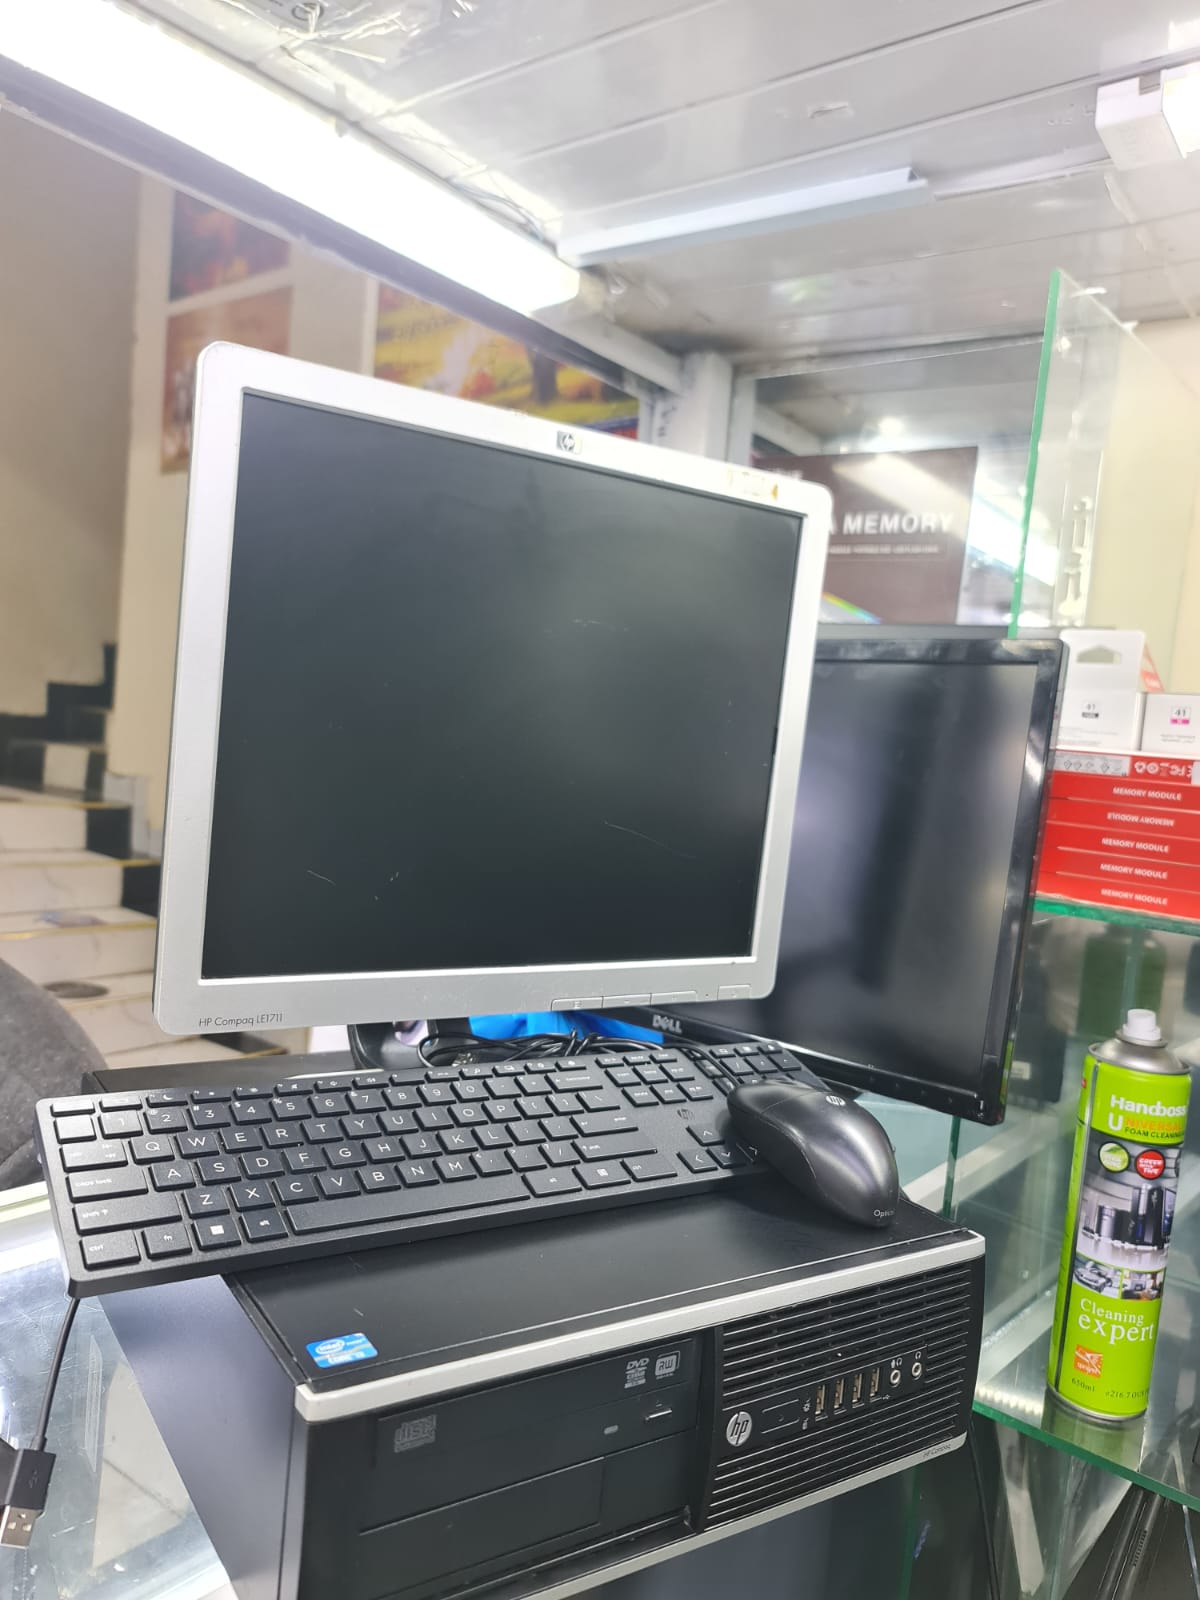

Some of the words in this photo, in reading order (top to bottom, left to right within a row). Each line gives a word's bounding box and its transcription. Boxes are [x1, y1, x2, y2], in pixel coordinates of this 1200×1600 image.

[843, 511, 954, 535] MEMORY
[1113, 786, 1146, 798] MEMORY
[1147, 791, 1182, 801] MODULE
[1101, 837, 1135, 848] MEMORY
[1136, 842, 1169, 853] MODULE
[1100, 863, 1133, 874] MEMORY
[1134, 868, 1168, 880] MODULE
[1101, 888, 1133, 899] MEMORY
[1134, 893, 1168, 905] MODULE
[199, 1017, 213, 1027] HP
[214, 1016, 254, 1027] Compaq
[256, 1013, 283, 1024] LE1711
[652, 1013, 682, 1034] DELL
[361, 1095, 369, 1103] 7
[397, 1092, 407, 1100] 8
[285, 1102, 296, 1111] 5
[324, 1098, 335, 1107] 6
[204, 1109, 215, 1118] 3
[246, 1106, 256, 1114] 4
[496, 1104, 506, 1113] P
[161, 1114, 172, 1123] 2
[353, 1119, 365, 1129] Y
[391, 1115, 404, 1125] U
[275, 1128, 289, 1139] R
[315, 1123, 326, 1133] T
[1125, 1126, 1149, 1137] FOAM
[234, 1132, 247, 1143] E
[451, 1134, 465, 1144] K
[487, 1130, 499, 1140] L
[145, 1141, 161, 1152] Q
[187, 1136, 206, 1147] W
[419, 1138, 427, 1149] J
[338, 1147, 352, 1158] G
[377, 1143, 391, 1153] H
[255, 1157, 269, 1168] D
[298, 1152, 310, 1164] F
[213, 1162, 226, 1173] S
[410, 1165, 425, 1176] N
[448, 1161, 463, 1172] M
[167, 1168, 182, 1179] A
[372, 1171, 385, 1182] B
[330, 1176, 343, 1187] V
[245, 1187, 260, 1199] X
[289, 1182, 304, 1193] C
[199, 1193, 214, 1206] Z
[1080, 1298, 1145, 1327] Cleaning
[1078, 1314, 1155, 1345] expert
[626, 1357, 650, 1370] DVD
[728, 1411, 752, 1447] hp
